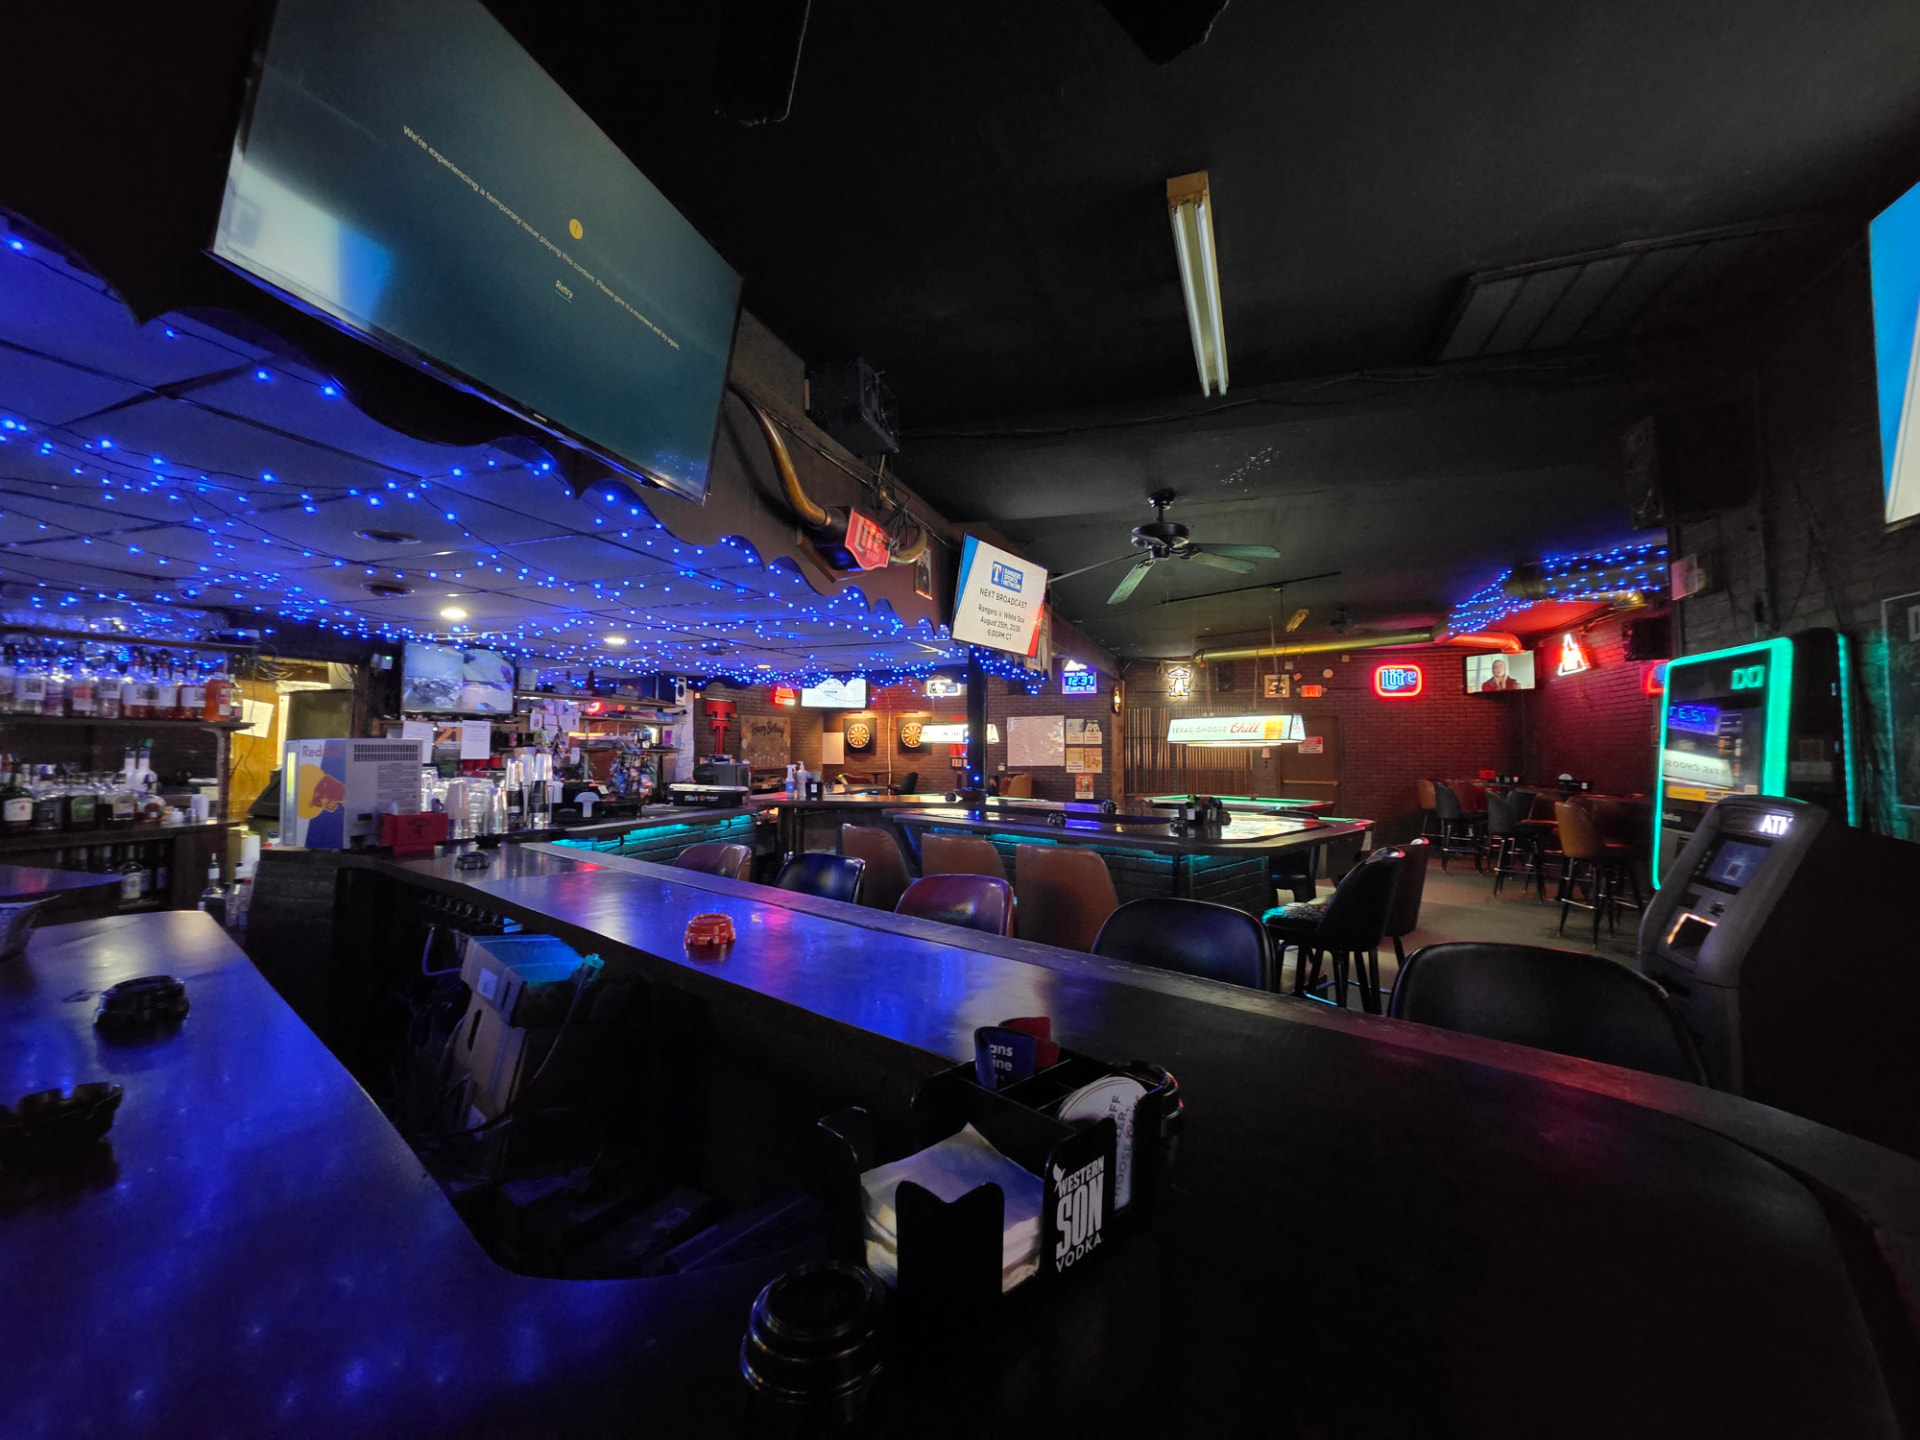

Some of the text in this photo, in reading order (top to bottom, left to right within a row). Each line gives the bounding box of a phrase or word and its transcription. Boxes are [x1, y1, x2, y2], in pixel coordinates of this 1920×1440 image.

[403, 125, 427, 150] We're
[428, 147, 479, 192] experiencing
[479, 187, 486, 196] a
[486, 191, 521, 224] temporary
[521, 220, 539, 238] issue
[538, 235, 561, 257] playing
[561, 252, 573, 265] this
[596, 279, 614, 297] Please
[555, 279, 574, 299] Retry
[979, 587, 1028, 609] NEXT BROADCAST
[978, 604, 998, 616] Rangers
[1003, 612, 1017, 622] White
[1016, 615, 1025, 624] Sox
[980, 615, 998, 628] August
[1005, 632, 1012, 641] CT
[1381, 669, 1417, 690] Lite
[1229, 722, 1262, 734] Chill
[302, 744, 324, 758] Red
[1059, 1155, 1104, 1199] WESTERN
[1114, 1144, 1132, 1206] HOOSE
[1056, 1172, 1104, 1260] SON
[1056, 1237, 1102, 1273] VODKA
